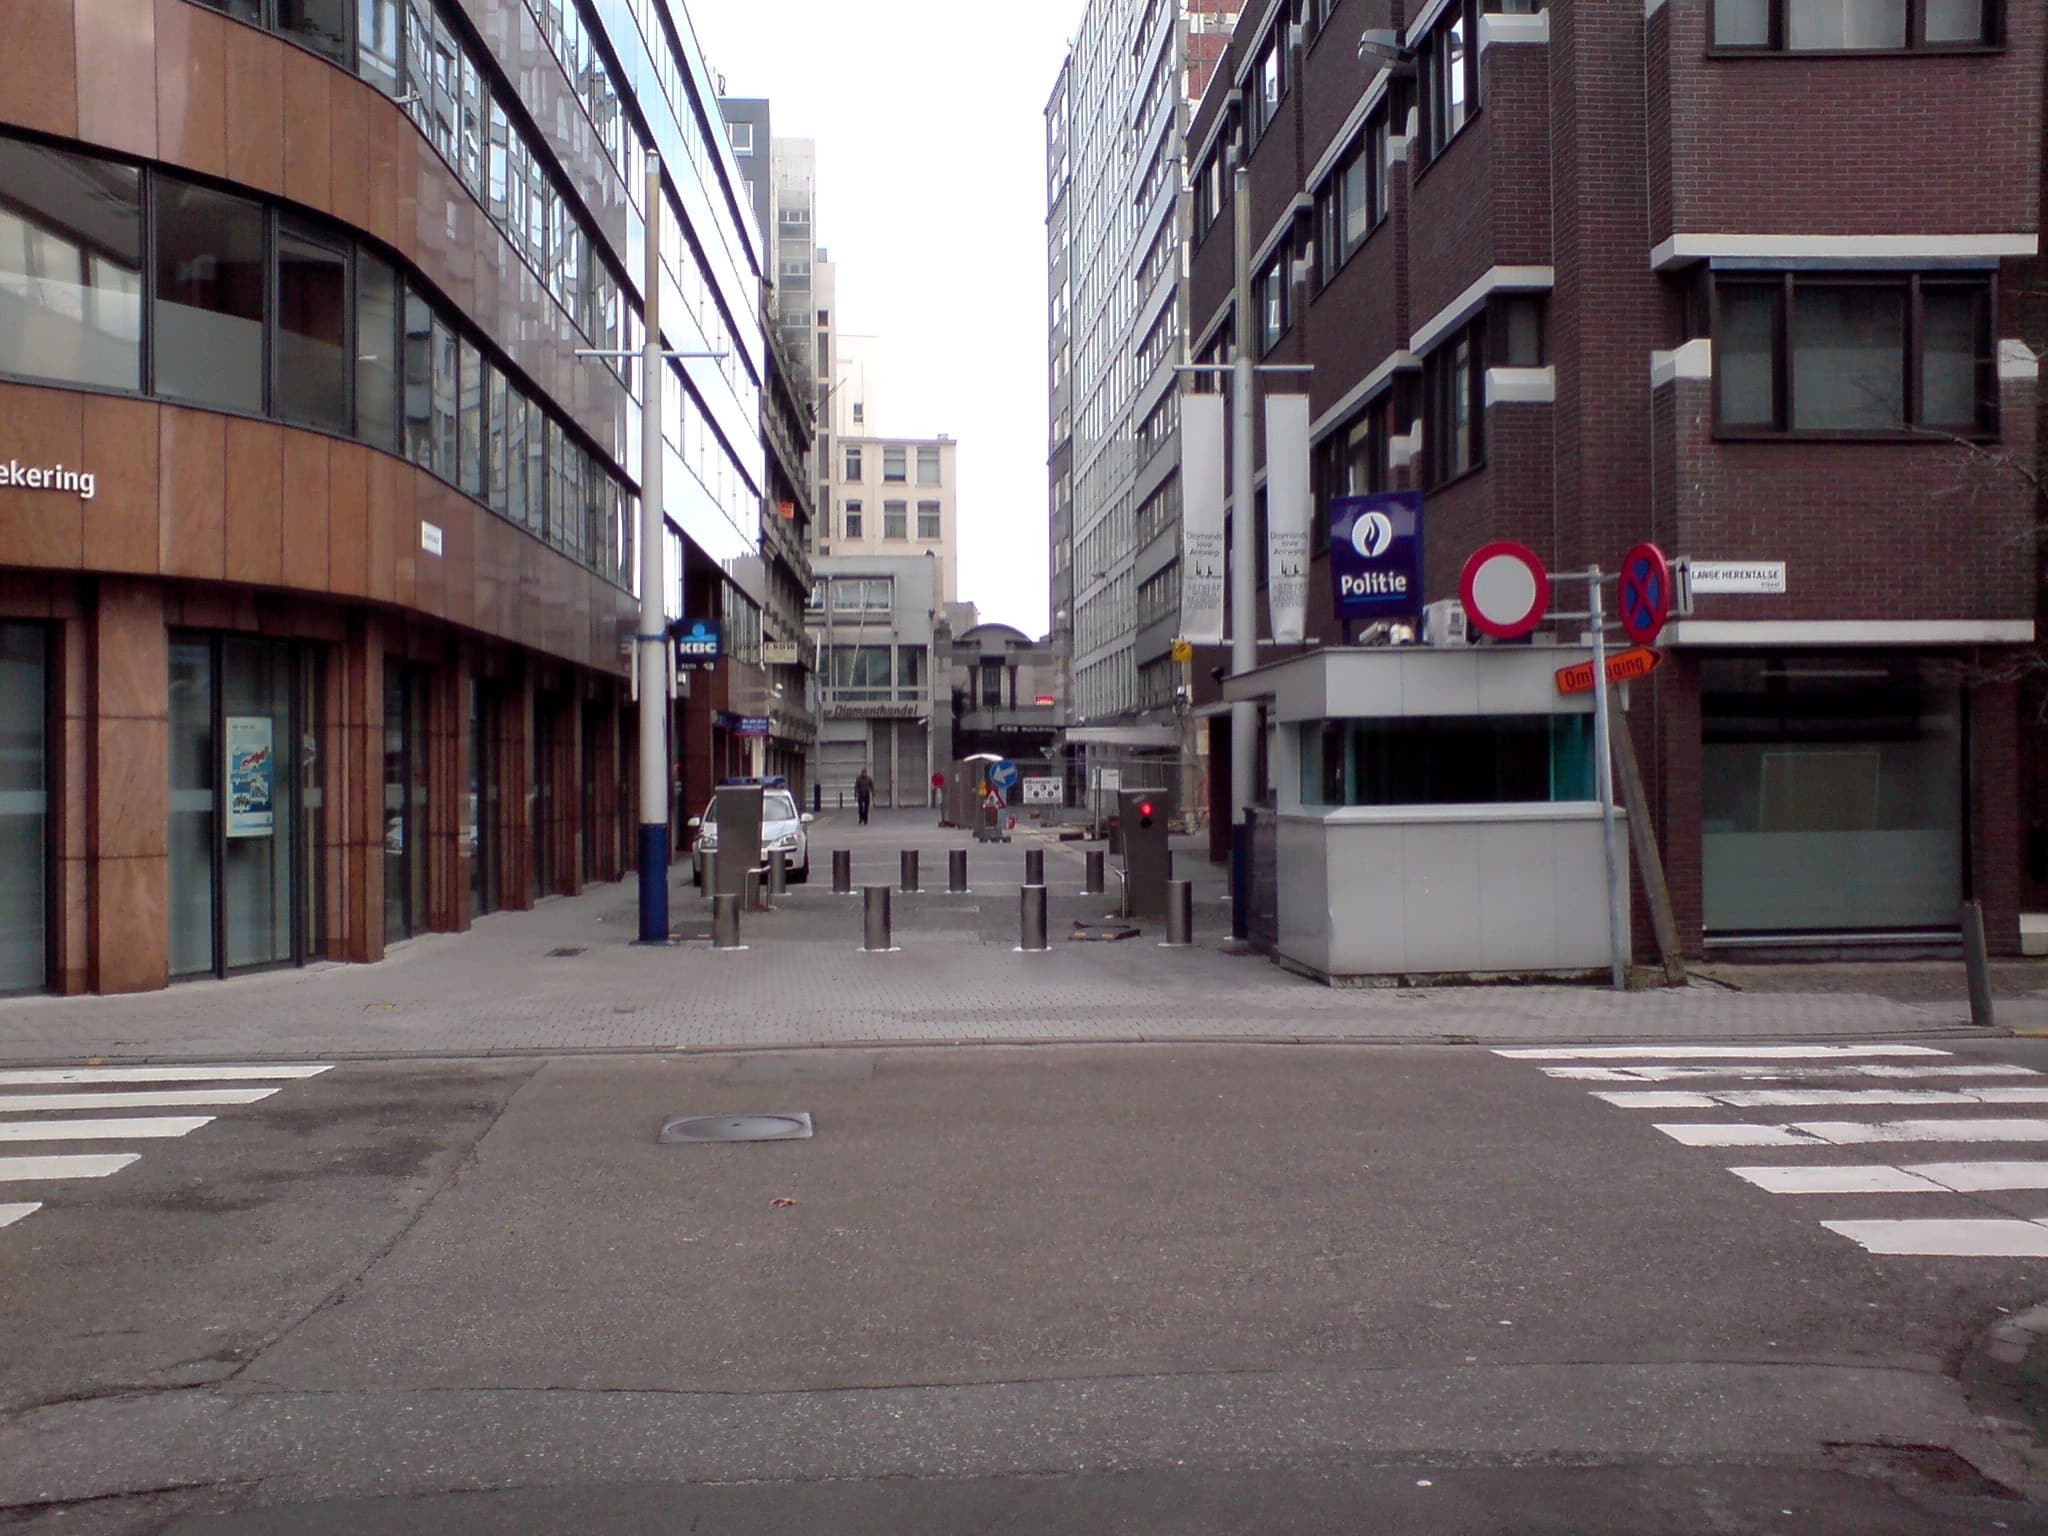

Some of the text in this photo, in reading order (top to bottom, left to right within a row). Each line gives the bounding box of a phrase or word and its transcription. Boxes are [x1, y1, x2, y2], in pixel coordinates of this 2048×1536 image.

[0, 459, 96, 500] ekering
[1341, 570, 1407, 596] Politie
[1691, 569, 1779, 580] LANGE HERENTALSE
[679, 642, 717, 655] KBC
[1564, 656, 1645, 688] Omlgging
[833, 703, 919, 718] Diamanthandel
